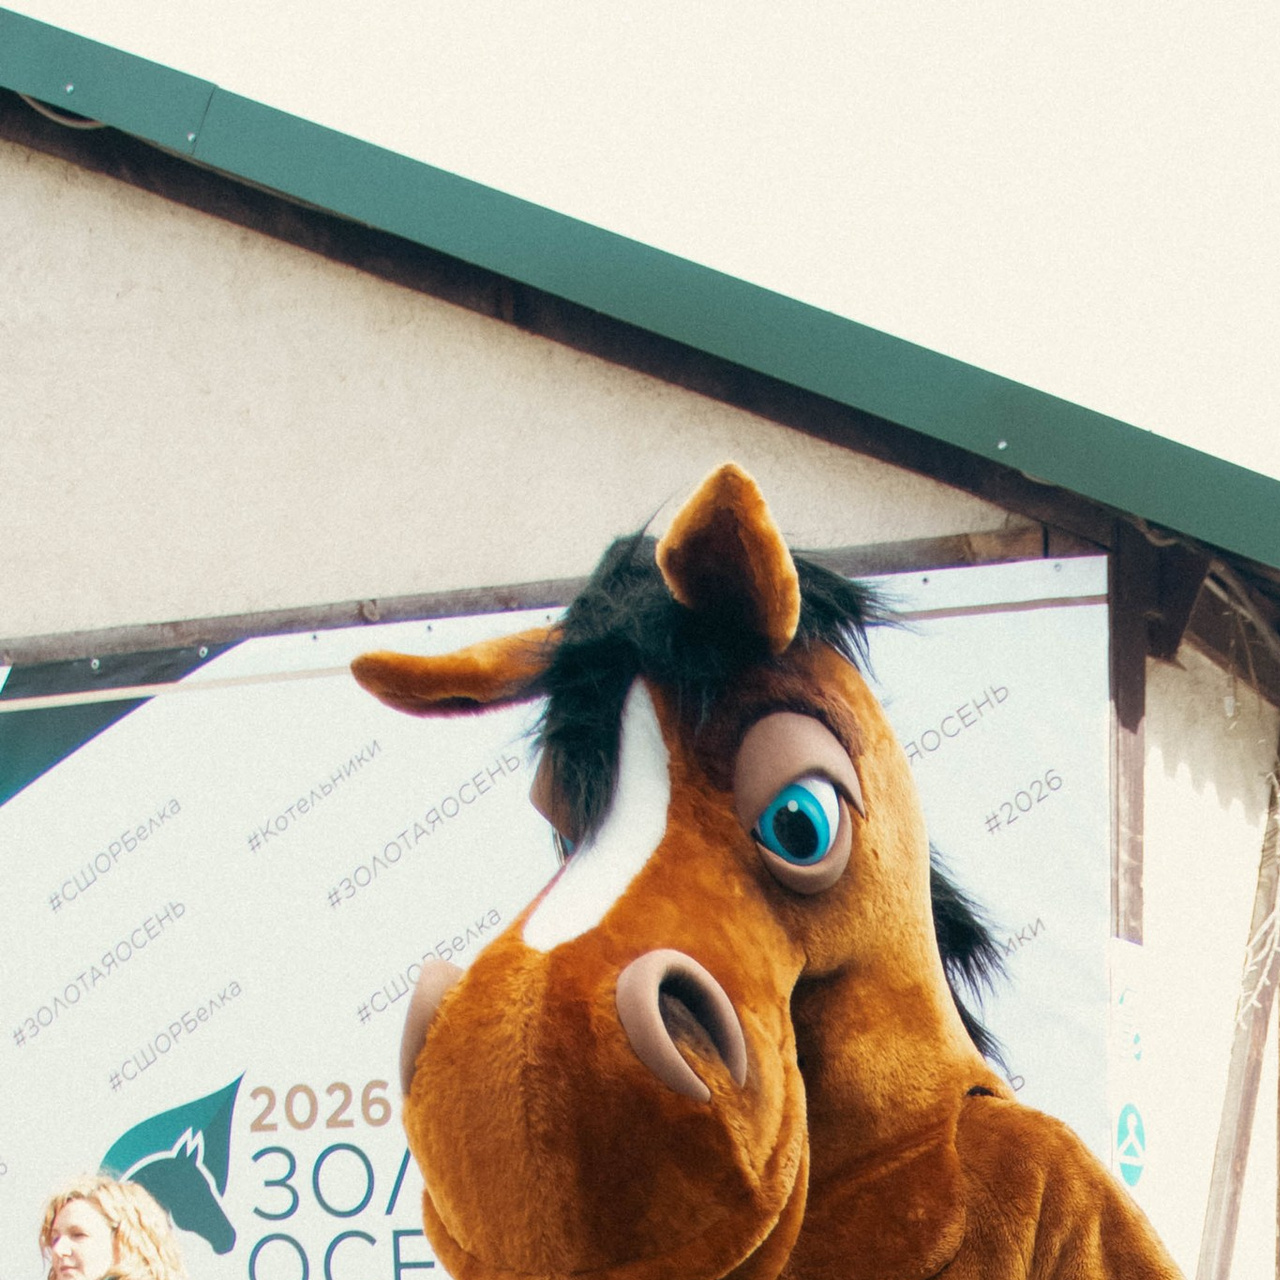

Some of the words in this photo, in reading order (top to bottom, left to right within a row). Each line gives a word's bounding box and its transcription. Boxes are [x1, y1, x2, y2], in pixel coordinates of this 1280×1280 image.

[248, 739, 382, 853] #Котельники
[328, 754, 521, 908] #ЗОЛОТАЯОСЕНЬ
[985, 769, 1062, 834] #2026
[50, 798, 182, 913] #СШОРБелка
[13, 901, 186, 1047] #ЗОЛОТАЯОСЕНЬ
[109, 980, 242, 1092] #СШОРБелка
[249, 1079, 392, 1132] 2026
